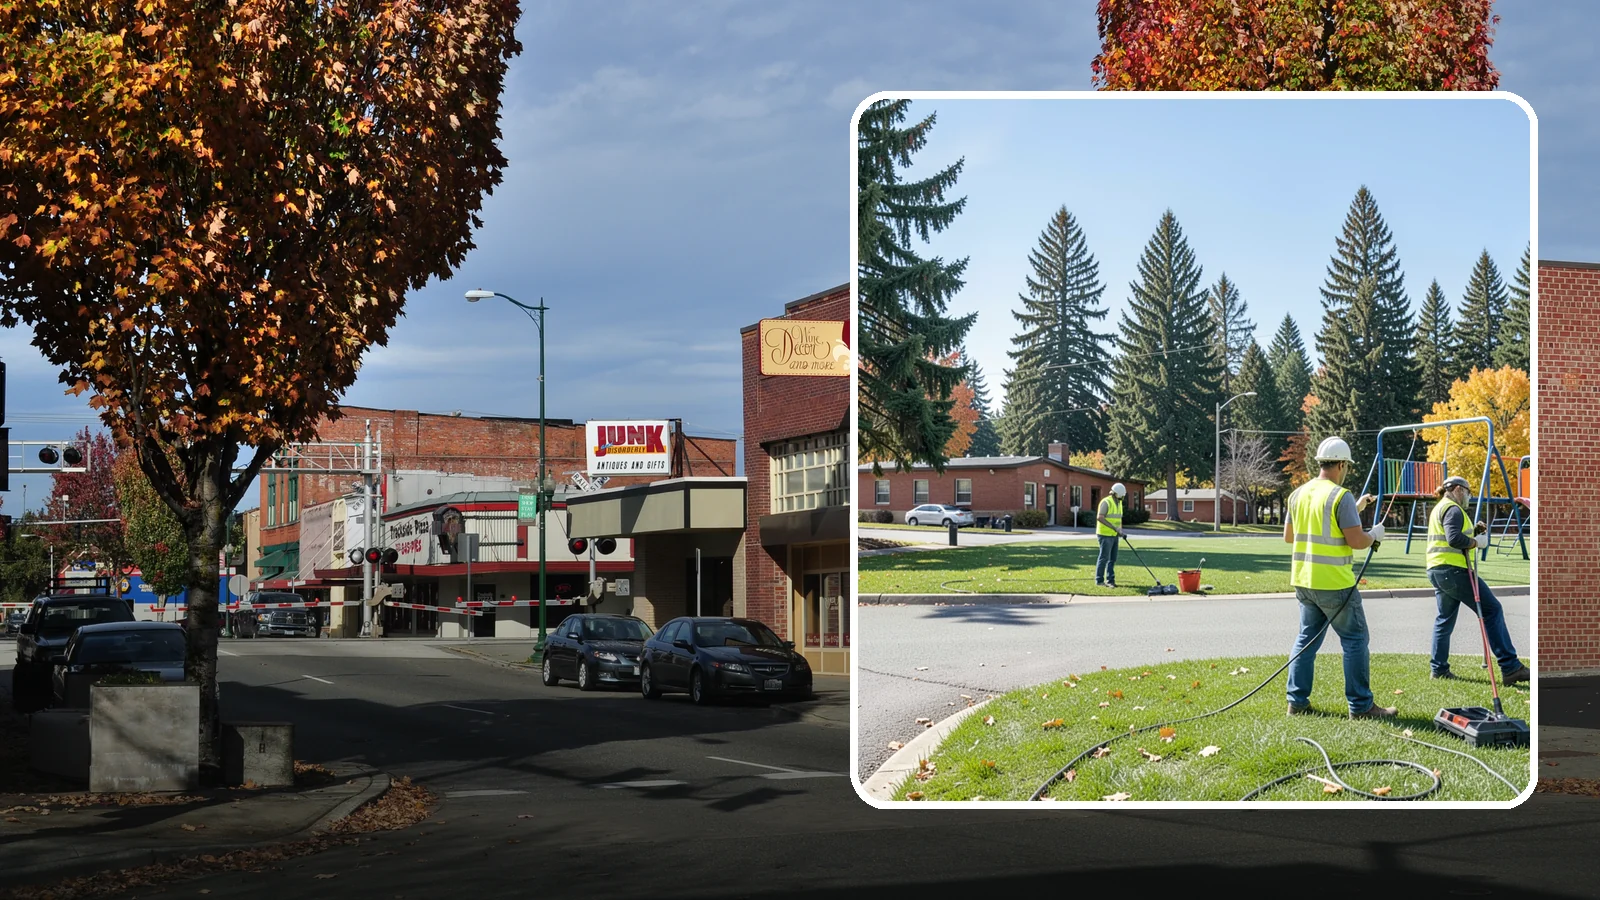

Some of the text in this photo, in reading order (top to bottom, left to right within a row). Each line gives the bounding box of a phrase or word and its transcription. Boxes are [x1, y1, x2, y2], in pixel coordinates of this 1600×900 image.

[595, 425, 665, 457] JUNK
[596, 460, 665, 470] ANTIQUES AND GIFTS
[573, 473, 589, 493] RAIL
[390, 519, 429, 540] Trackside Pizza
